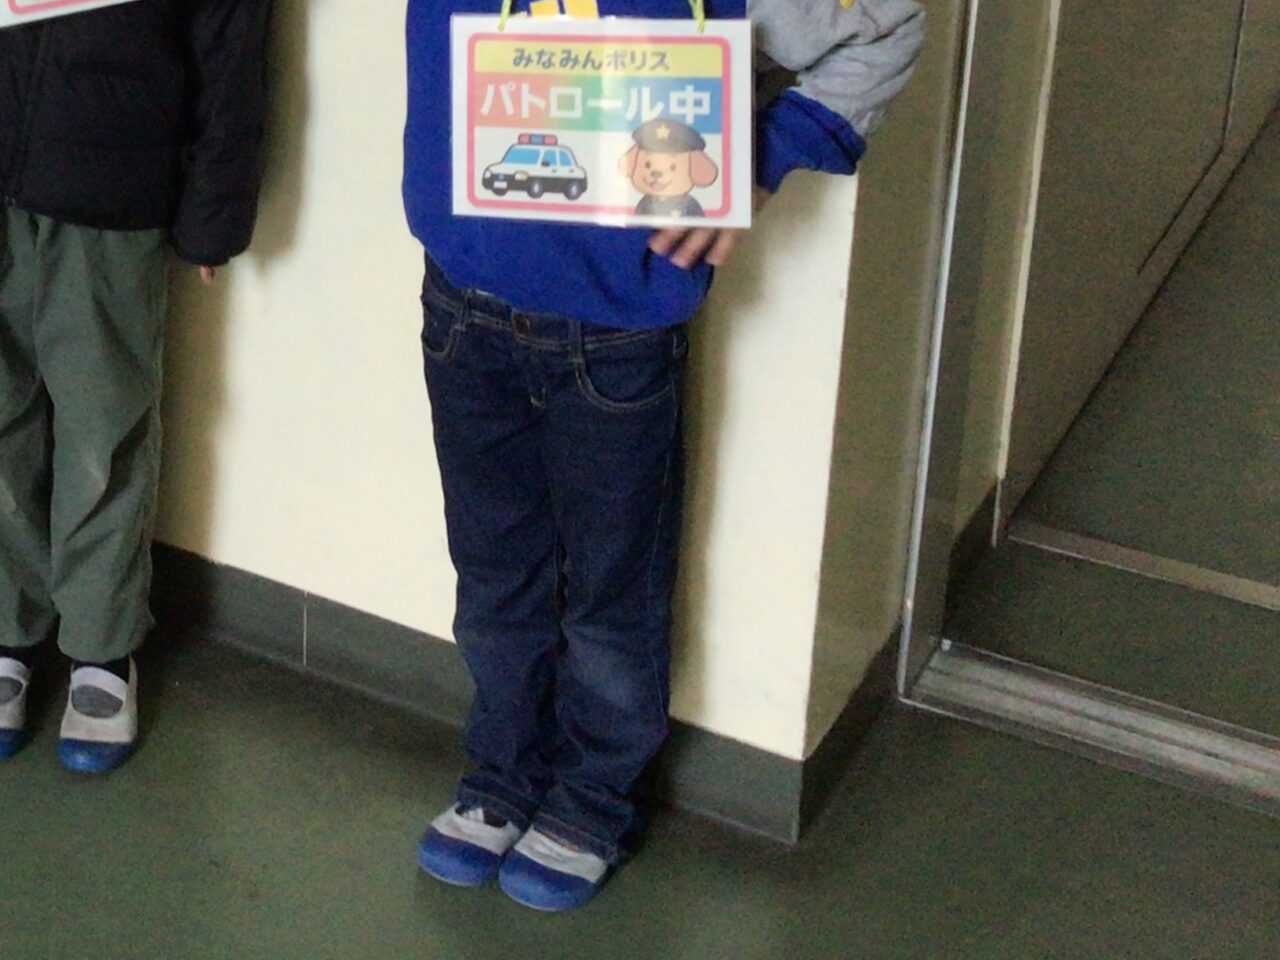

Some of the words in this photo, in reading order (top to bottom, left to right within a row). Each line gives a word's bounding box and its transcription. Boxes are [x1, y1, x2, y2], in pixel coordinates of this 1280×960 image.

[480, 80, 711, 125] パトロール中
